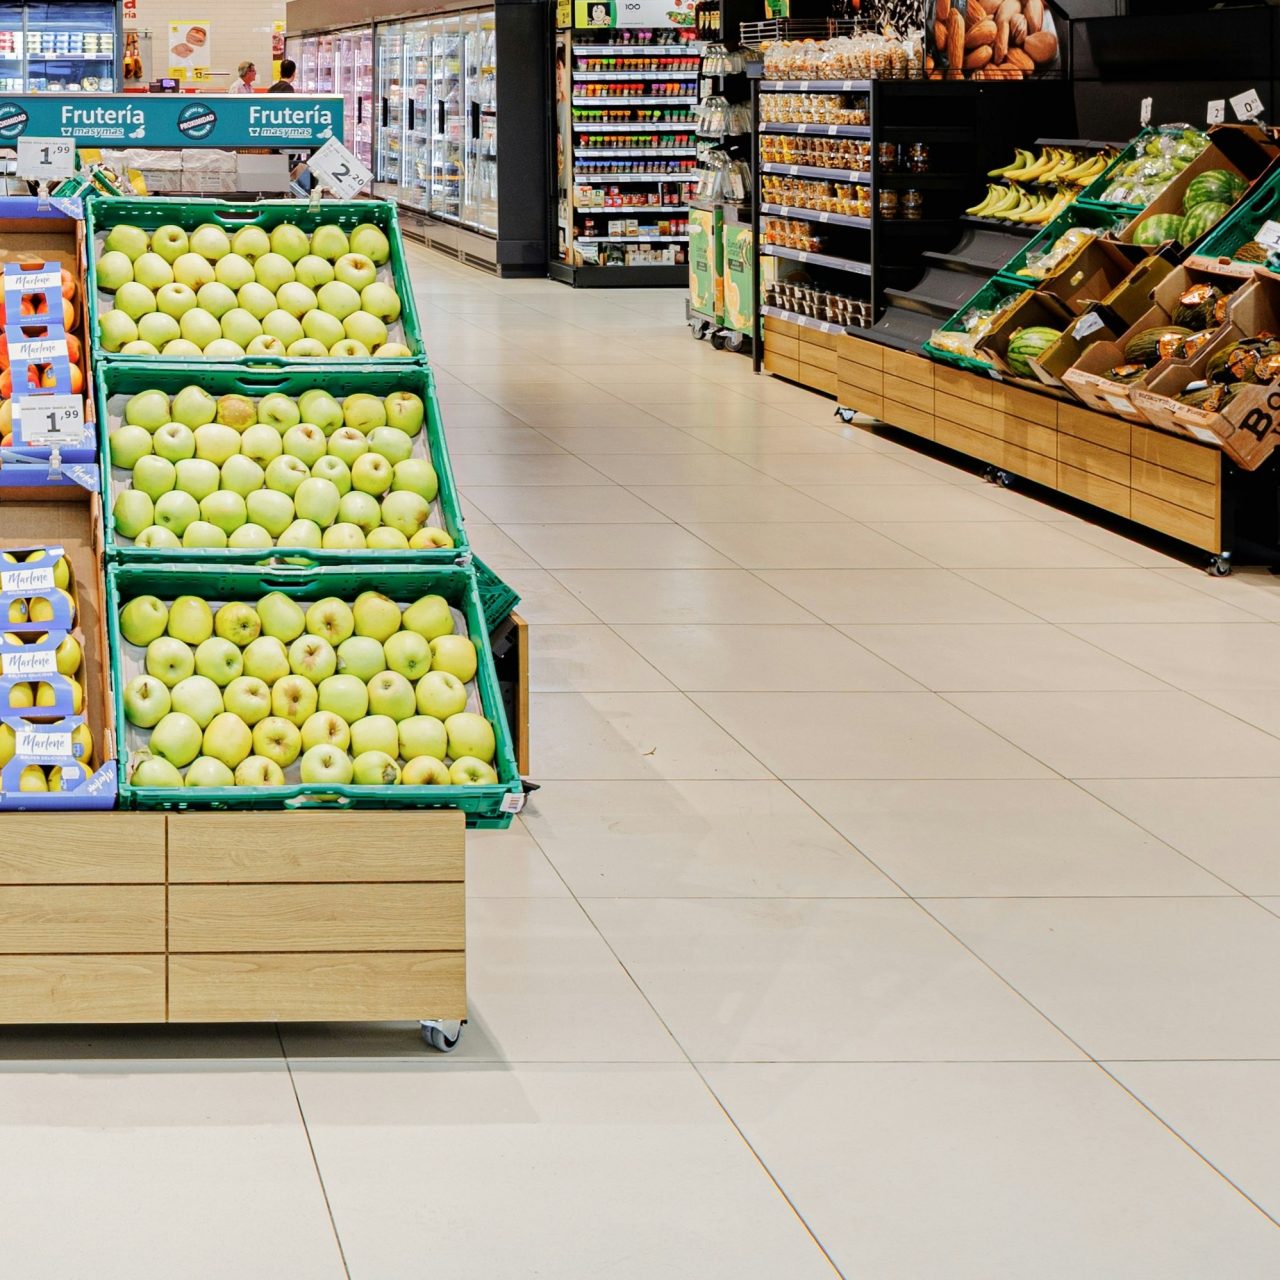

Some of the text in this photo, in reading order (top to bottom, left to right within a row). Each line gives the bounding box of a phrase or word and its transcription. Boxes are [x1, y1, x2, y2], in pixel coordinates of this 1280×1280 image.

[61, 104, 145, 124] Frutería
[179, 113, 215, 131] PROXIMIDAD
[249, 104, 333, 125] Frutería
[73, 126, 125, 139] masymas
[261, 126, 313, 139] masymas
[15, 274, 51, 291] Marlene
[20, 343, 56, 358] Marlene
[46, 409, 79, 433] 1,99
[8, 571, 49, 589] Marlene
[9, 652, 50, 670] Marlene
[22, 733, 65, 753] Marlene
